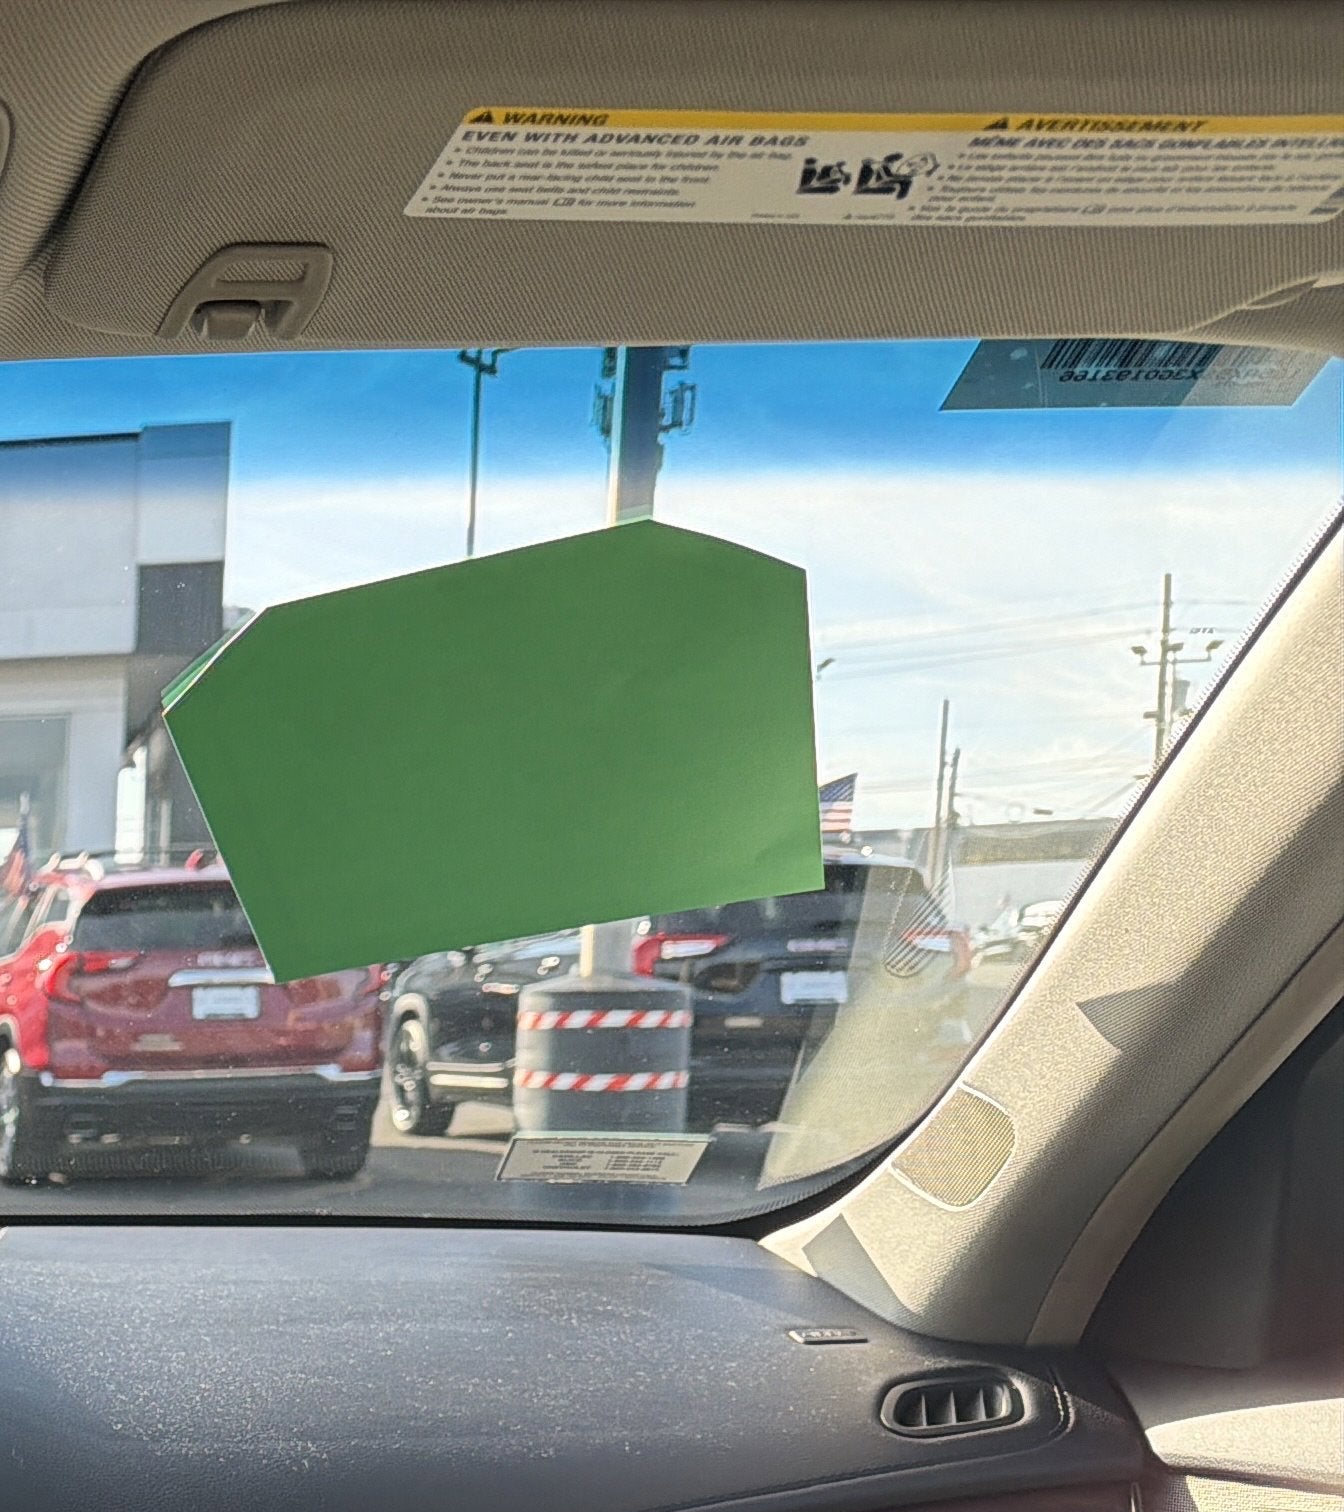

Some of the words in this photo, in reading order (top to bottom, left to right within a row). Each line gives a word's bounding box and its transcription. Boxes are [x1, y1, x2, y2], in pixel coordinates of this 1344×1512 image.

[502, 113, 610, 126] WARNING
[462, 131, 517, 142] EVEN
[523, 132, 578, 143] WITH
[582, 133, 700, 145] ADVANCED
[703, 135, 745, 146] AIR
[749, 135, 810, 147] BAGS
